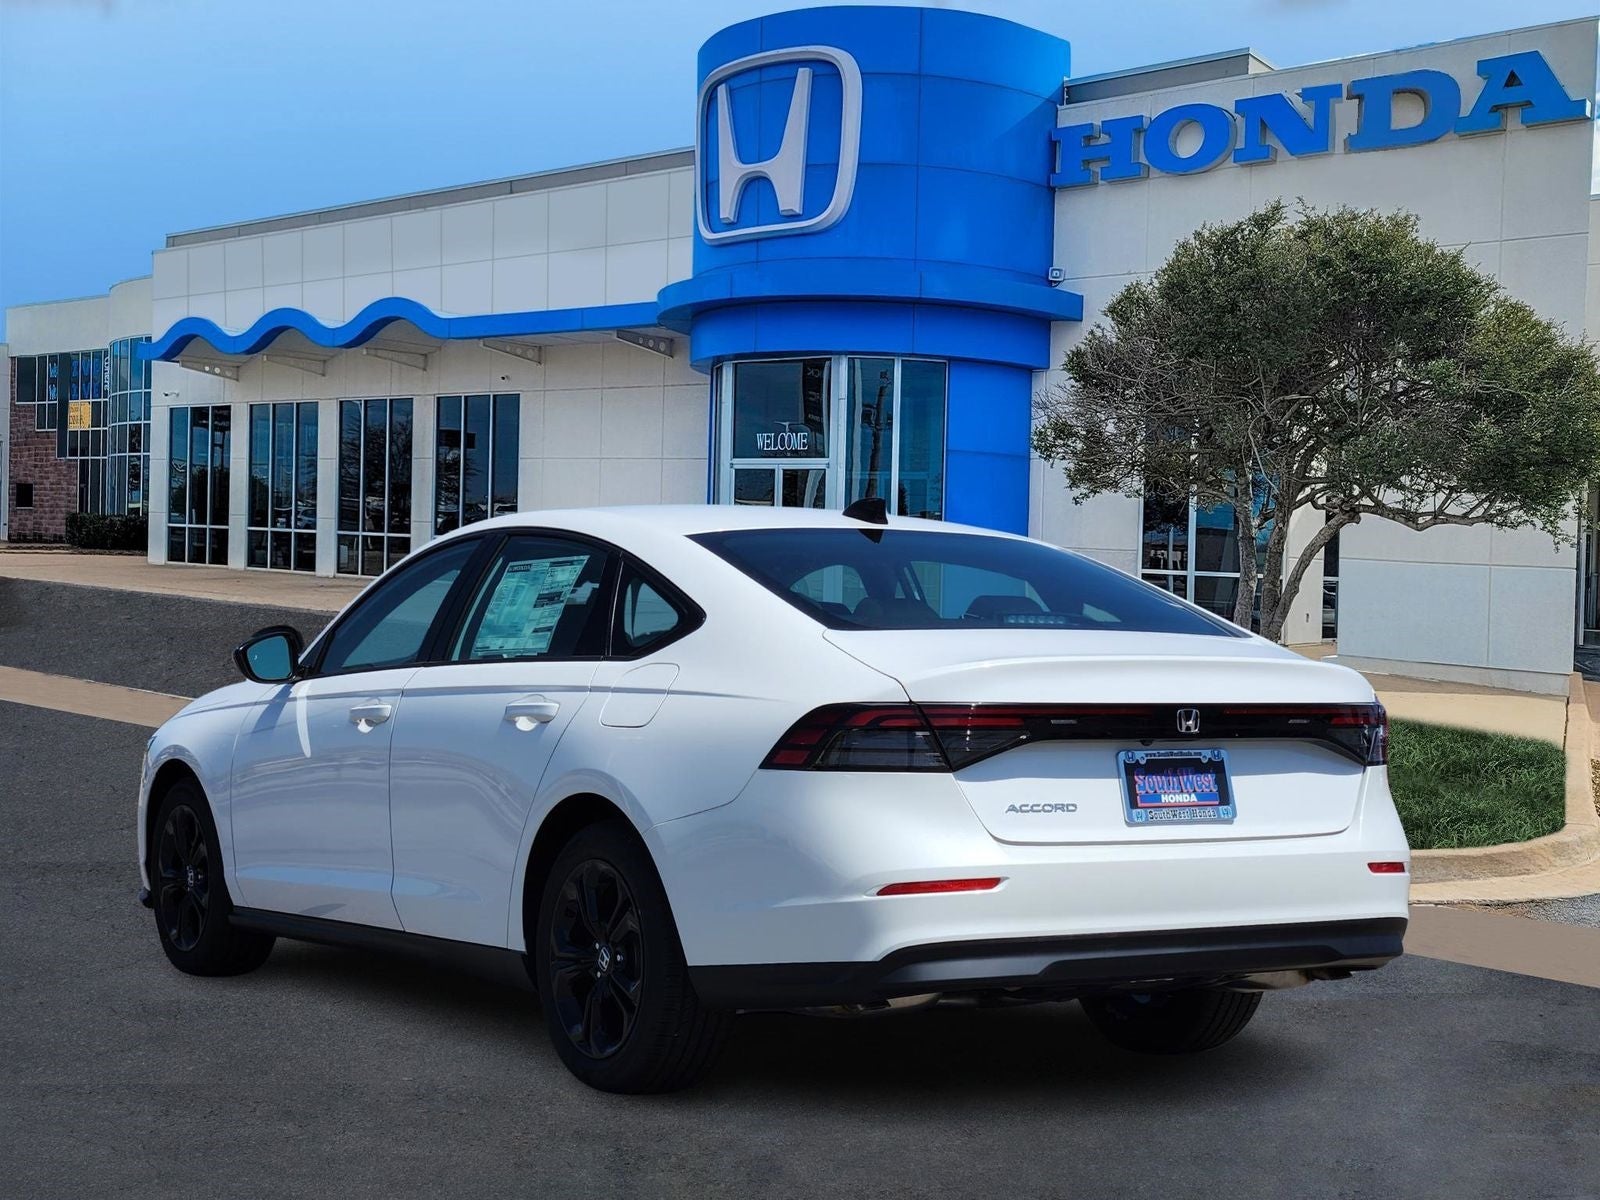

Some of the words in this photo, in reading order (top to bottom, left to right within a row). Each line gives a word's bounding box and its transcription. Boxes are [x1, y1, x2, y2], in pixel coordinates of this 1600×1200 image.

[1051, 50, 1591, 188] HONDA
[756, 432, 809, 451] WELCOME
[1161, 793, 1198, 803] HONDA
[1005, 803, 1078, 814] ACCORD
[1148, 809, 1190, 820] SouthWest
[1191, 808, 1217, 818] Honda
